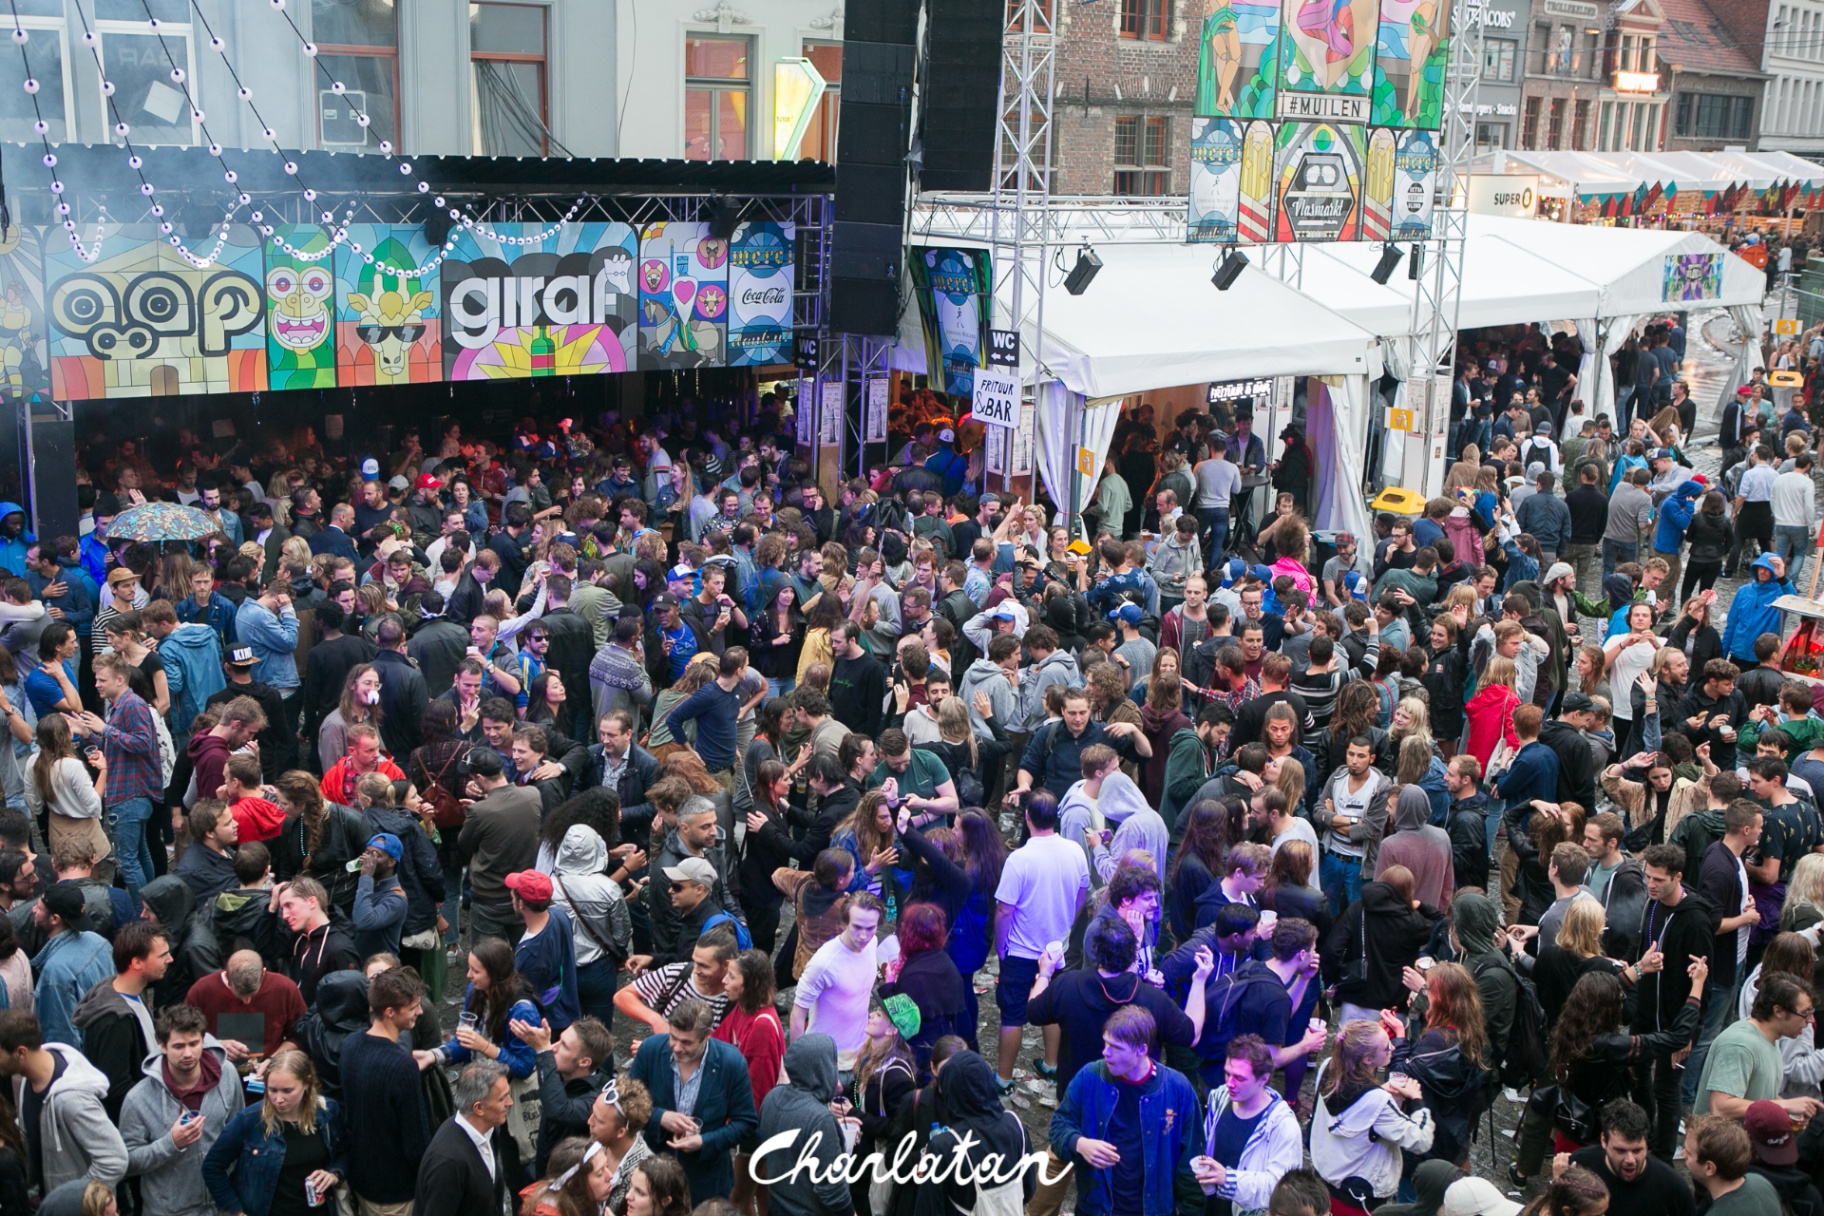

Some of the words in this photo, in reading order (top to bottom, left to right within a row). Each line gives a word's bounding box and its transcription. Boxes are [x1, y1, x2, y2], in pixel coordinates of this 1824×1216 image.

[1289, 96, 1361, 117] #MUILEN
[1496, 103, 1517, 115] Snacks
[1192, 142, 1241, 162] merci
[1397, 151, 1437, 170] merci
[1291, 199, 1344, 217] Vlasmarkt
[1494, 192, 1521, 206] SUPER
[731, 243, 793, 266] merci
[932, 271, 977, 294] merci
[450, 254, 631, 350] giraf
[731, 329, 771, 348] dank
[800, 340, 817, 355] WC
[993, 332, 1016, 350] WC
[1209, 385, 1244, 399] FRITUUR
